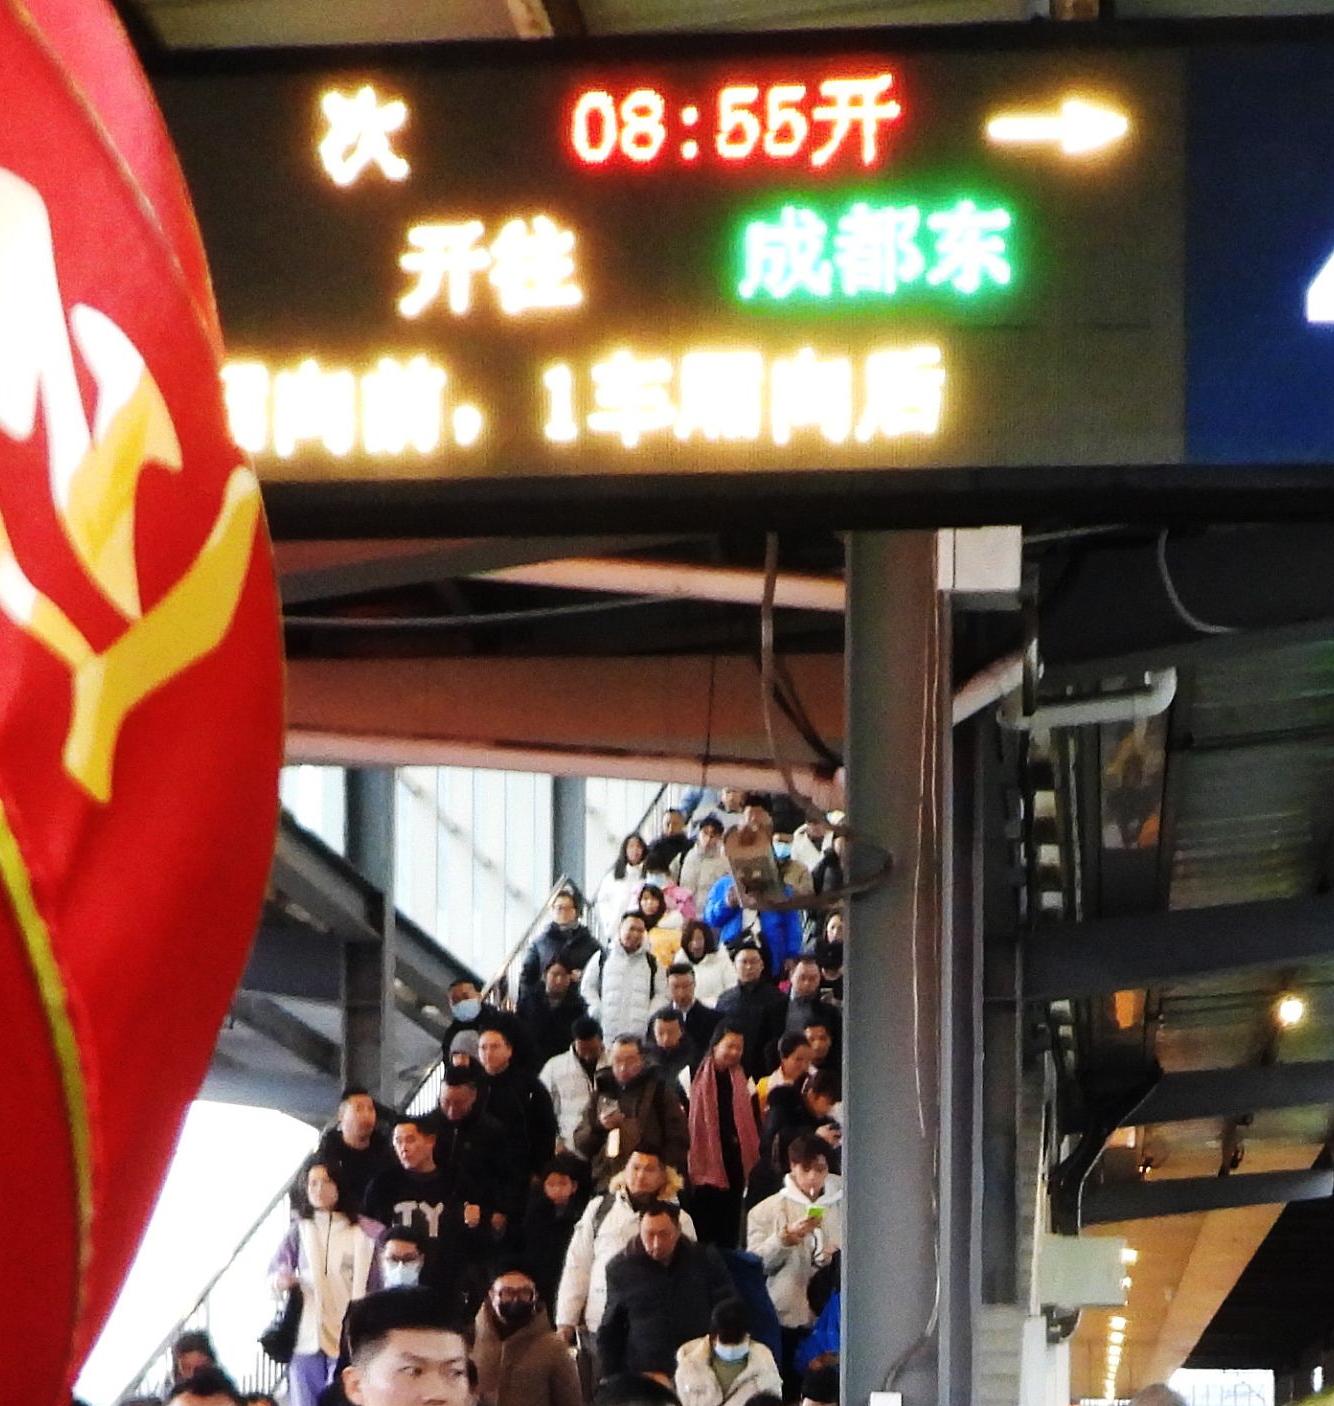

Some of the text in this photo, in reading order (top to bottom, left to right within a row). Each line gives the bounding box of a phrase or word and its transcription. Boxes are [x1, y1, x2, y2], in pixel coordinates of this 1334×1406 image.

[319, 72, 902, 184] 次 08:55开
[398, 200, 1013, 317] 开往 成都东
